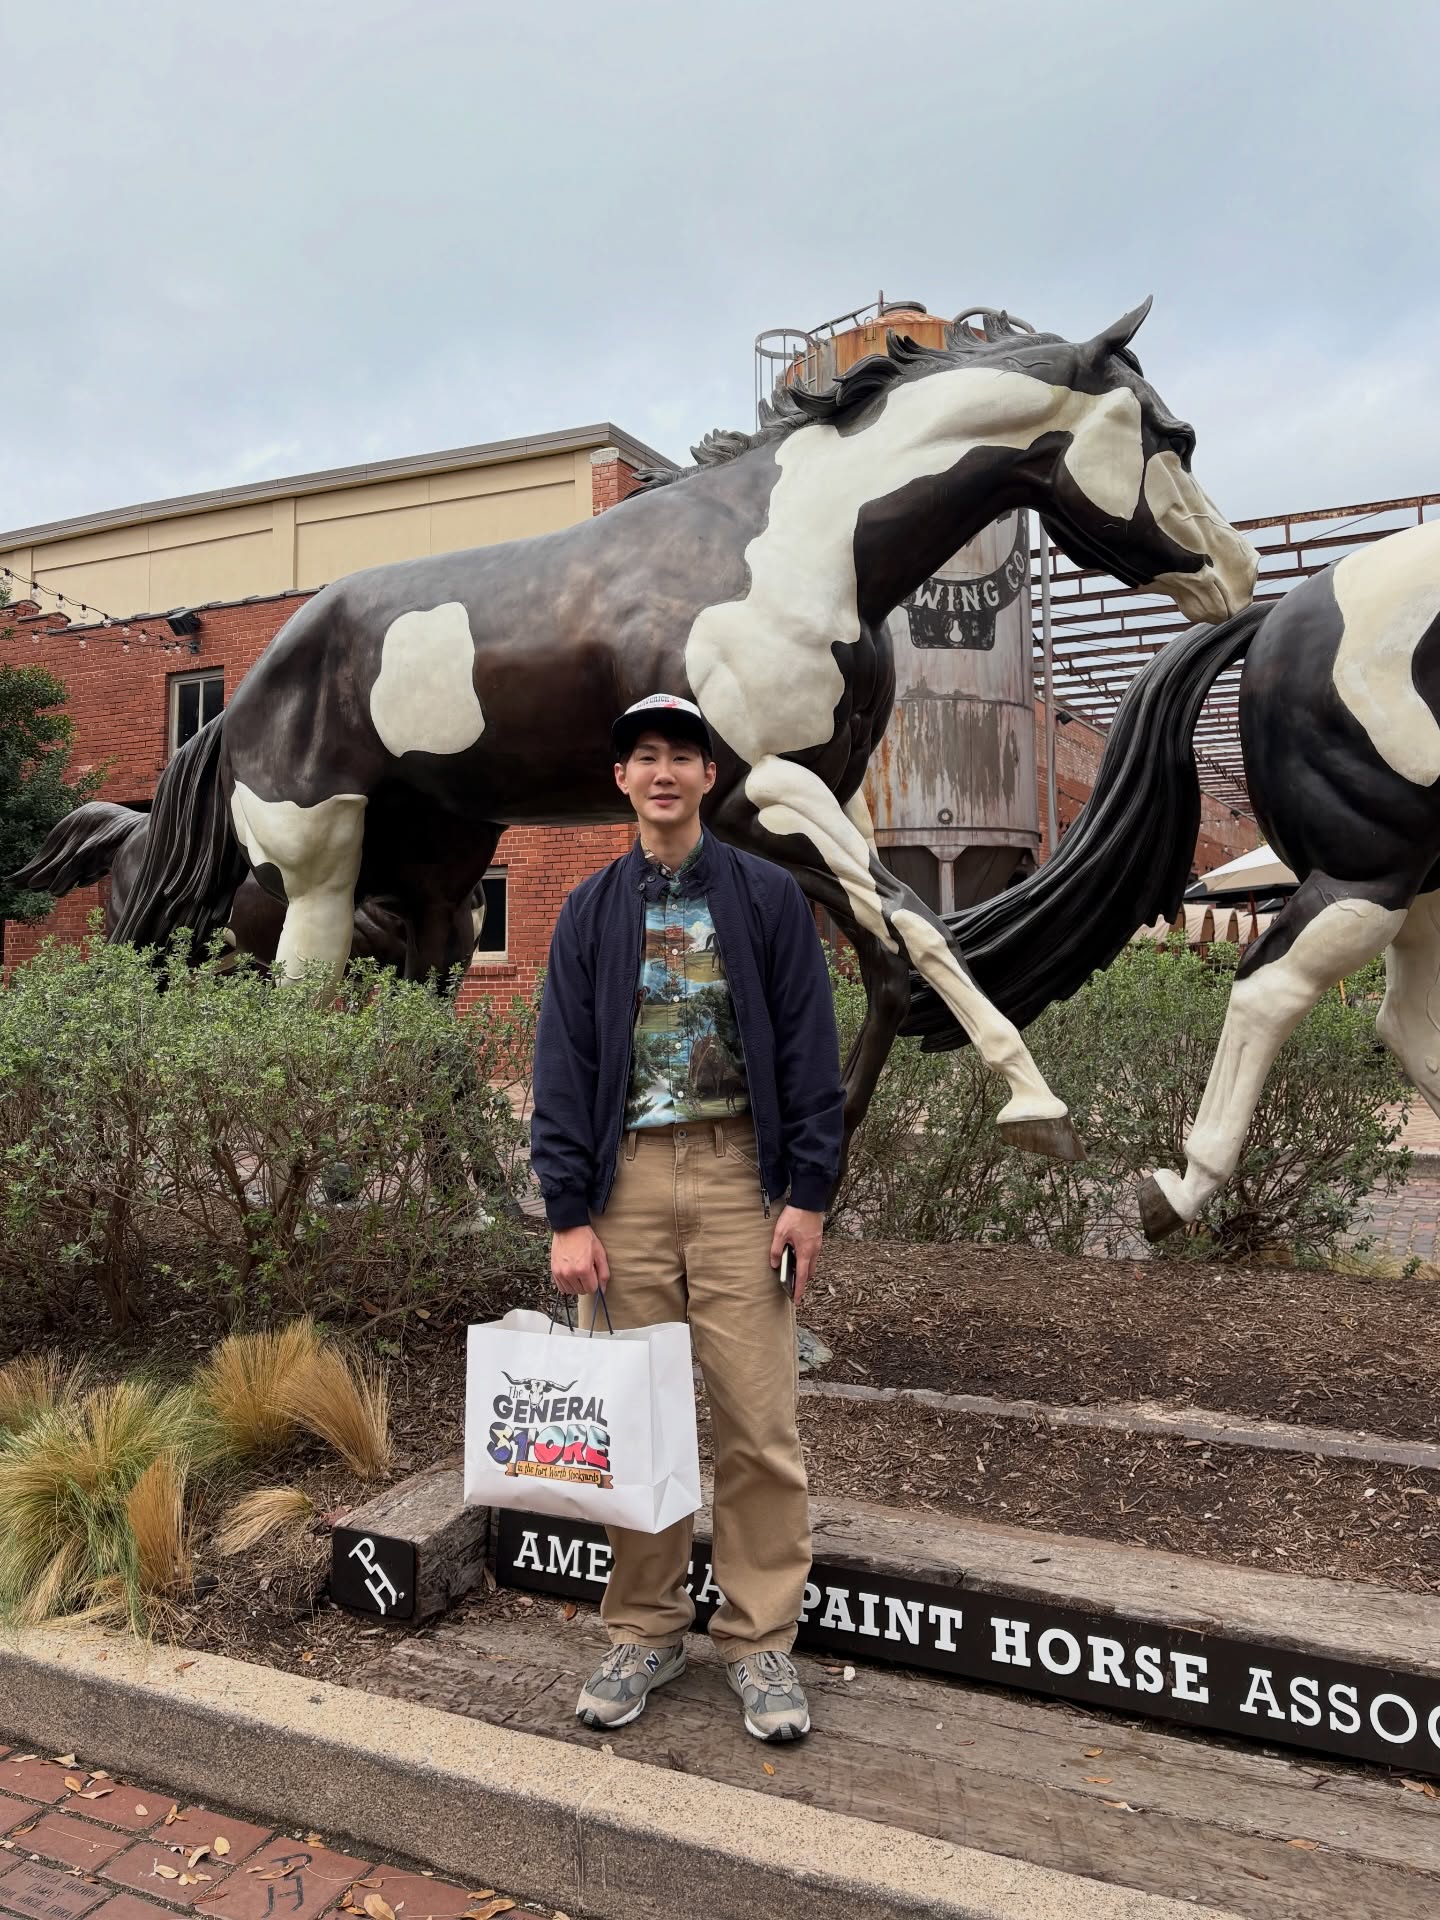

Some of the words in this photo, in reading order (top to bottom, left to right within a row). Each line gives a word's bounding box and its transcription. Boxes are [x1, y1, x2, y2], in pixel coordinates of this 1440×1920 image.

[509, 1386, 523, 1399] The
[493, 1395, 607, 1427] GENERAL
[487, 1422, 611, 1473] STORE
[517, 1462, 523, 1472] in
[524, 1464, 534, 1474] the
[535, 1465, 548, 1477] Fort
[549, 1466, 567, 1479] Worth
[568, 1468, 599, 1483] Stockyards
[798, 1582, 963, 1653] PAINT
[991, 1617, 1210, 1704] HORSE
[1239, 1667, 1440, 1750] ASSO
